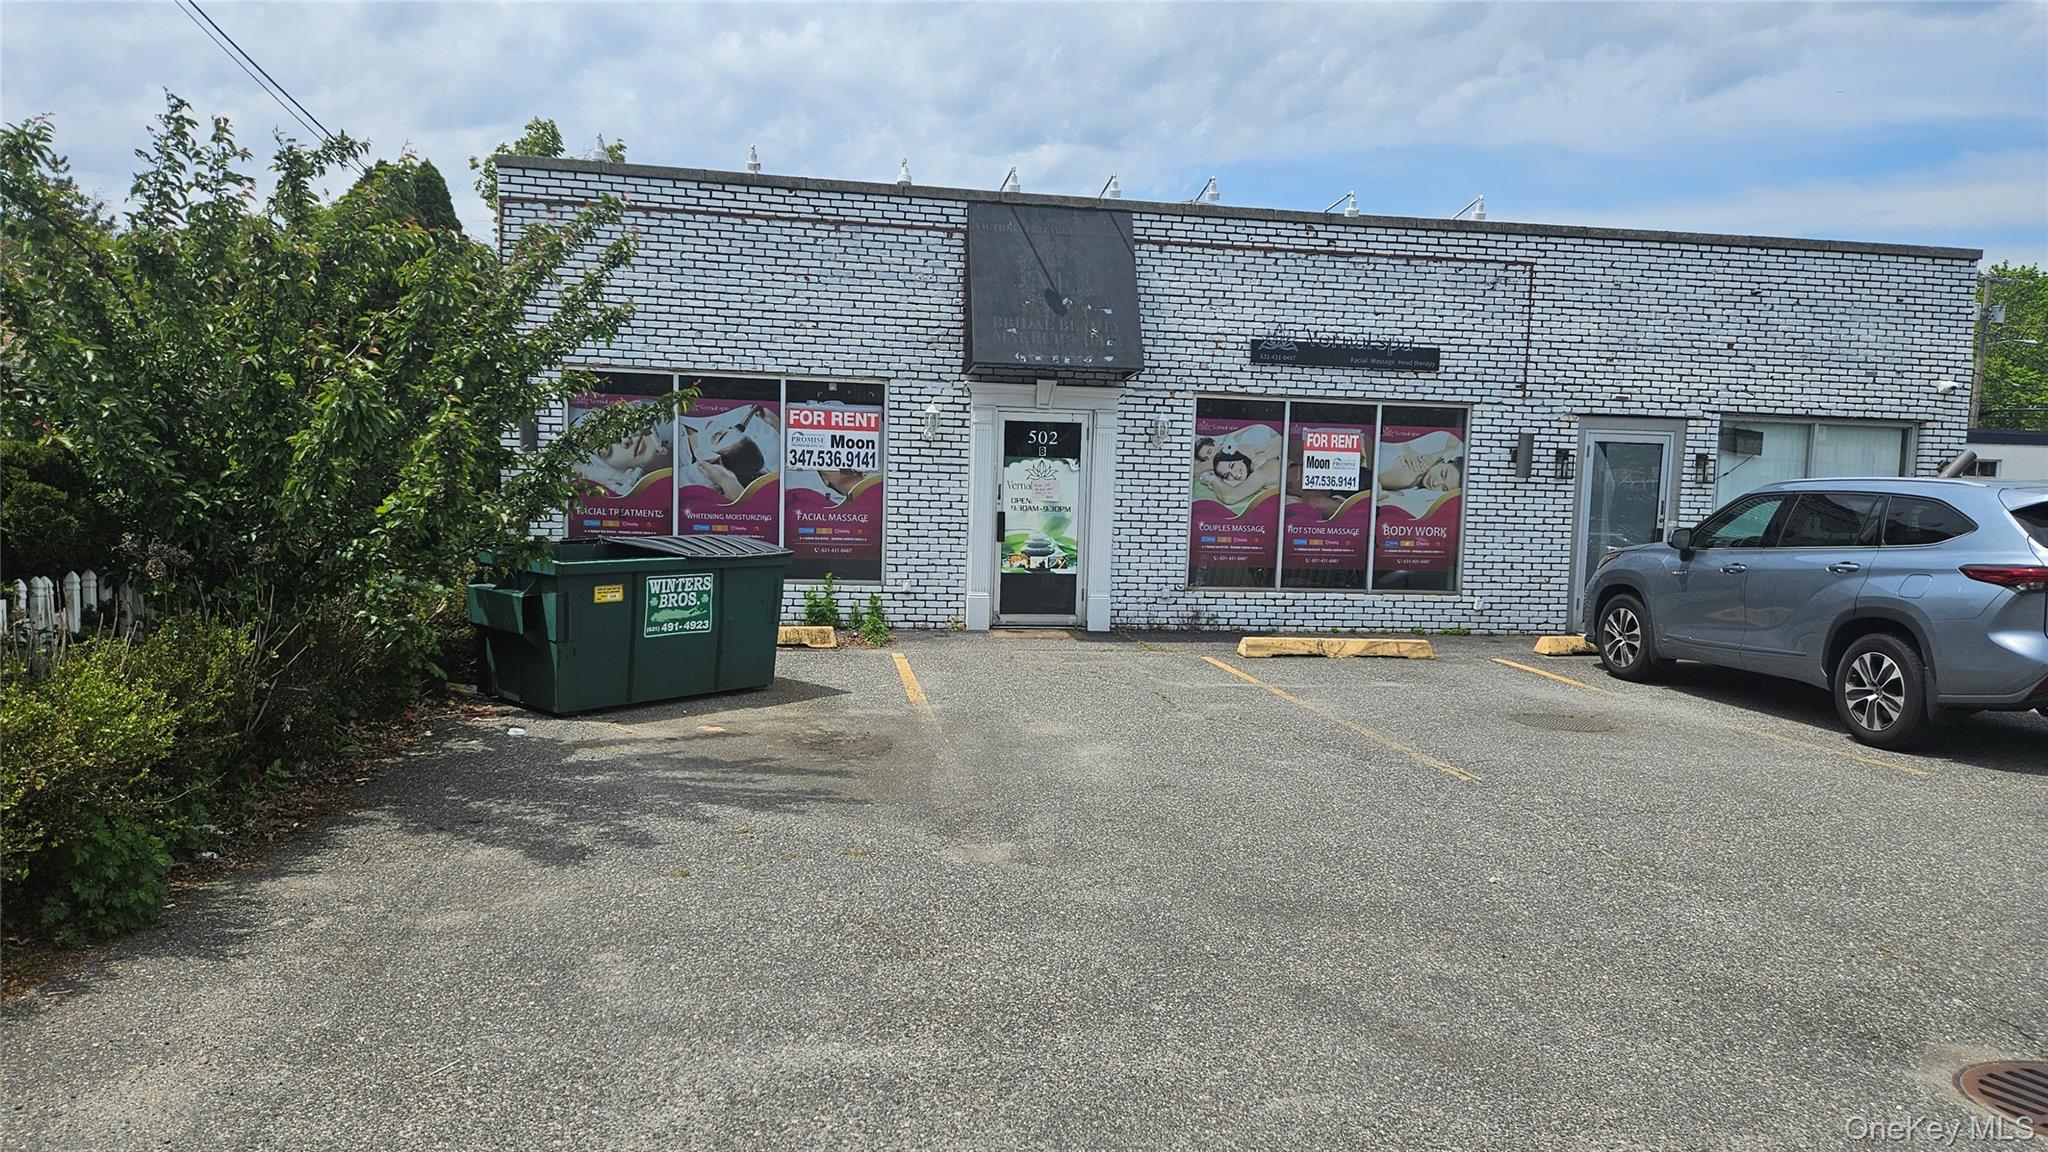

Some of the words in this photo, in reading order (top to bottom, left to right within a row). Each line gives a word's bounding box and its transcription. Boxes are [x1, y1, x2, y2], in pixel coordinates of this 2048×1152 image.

[1307, 328, 1372, 350] Vernal
[1376, 336, 1414, 357] spa
[789, 409, 826, 426] FOR
[831, 411, 879, 428] RENT
[791, 436, 826, 444] PROMISE
[830, 434, 876, 450] Moon
[1028, 430, 1058, 445] 502
[1306, 433, 1328, 448] FOR
[1331, 434, 1360, 449] RENT
[789, 449, 876, 469] 347.536.9141
[1306, 455, 1330, 470] Moon
[1006, 480, 1033, 490] Vernal
[1304, 475, 1357, 489] 347.536.9141
[577, 507, 607, 516] FACIAL
[609, 507, 664, 518] TREATMENTS
[687, 512, 725, 520] WHITENING
[725, 513, 772, 522] MOISTURIZING
[797, 513, 827, 521] FACIAL
[828, 513, 869, 522] MASSAGE
[1200, 524, 1231, 532] COUPLES
[1231, 525, 1265, 533] MASSAGE
[1288, 526, 1302, 534] HOT
[1303, 527, 1326, 535] STONE
[1326, 527, 1360, 536] MASSAGE
[1383, 526, 1413, 536] BODY
[1415, 526, 1447, 537] WORK
[648, 576, 711, 594] WINTERS
[658, 592, 700, 608] BROS.
